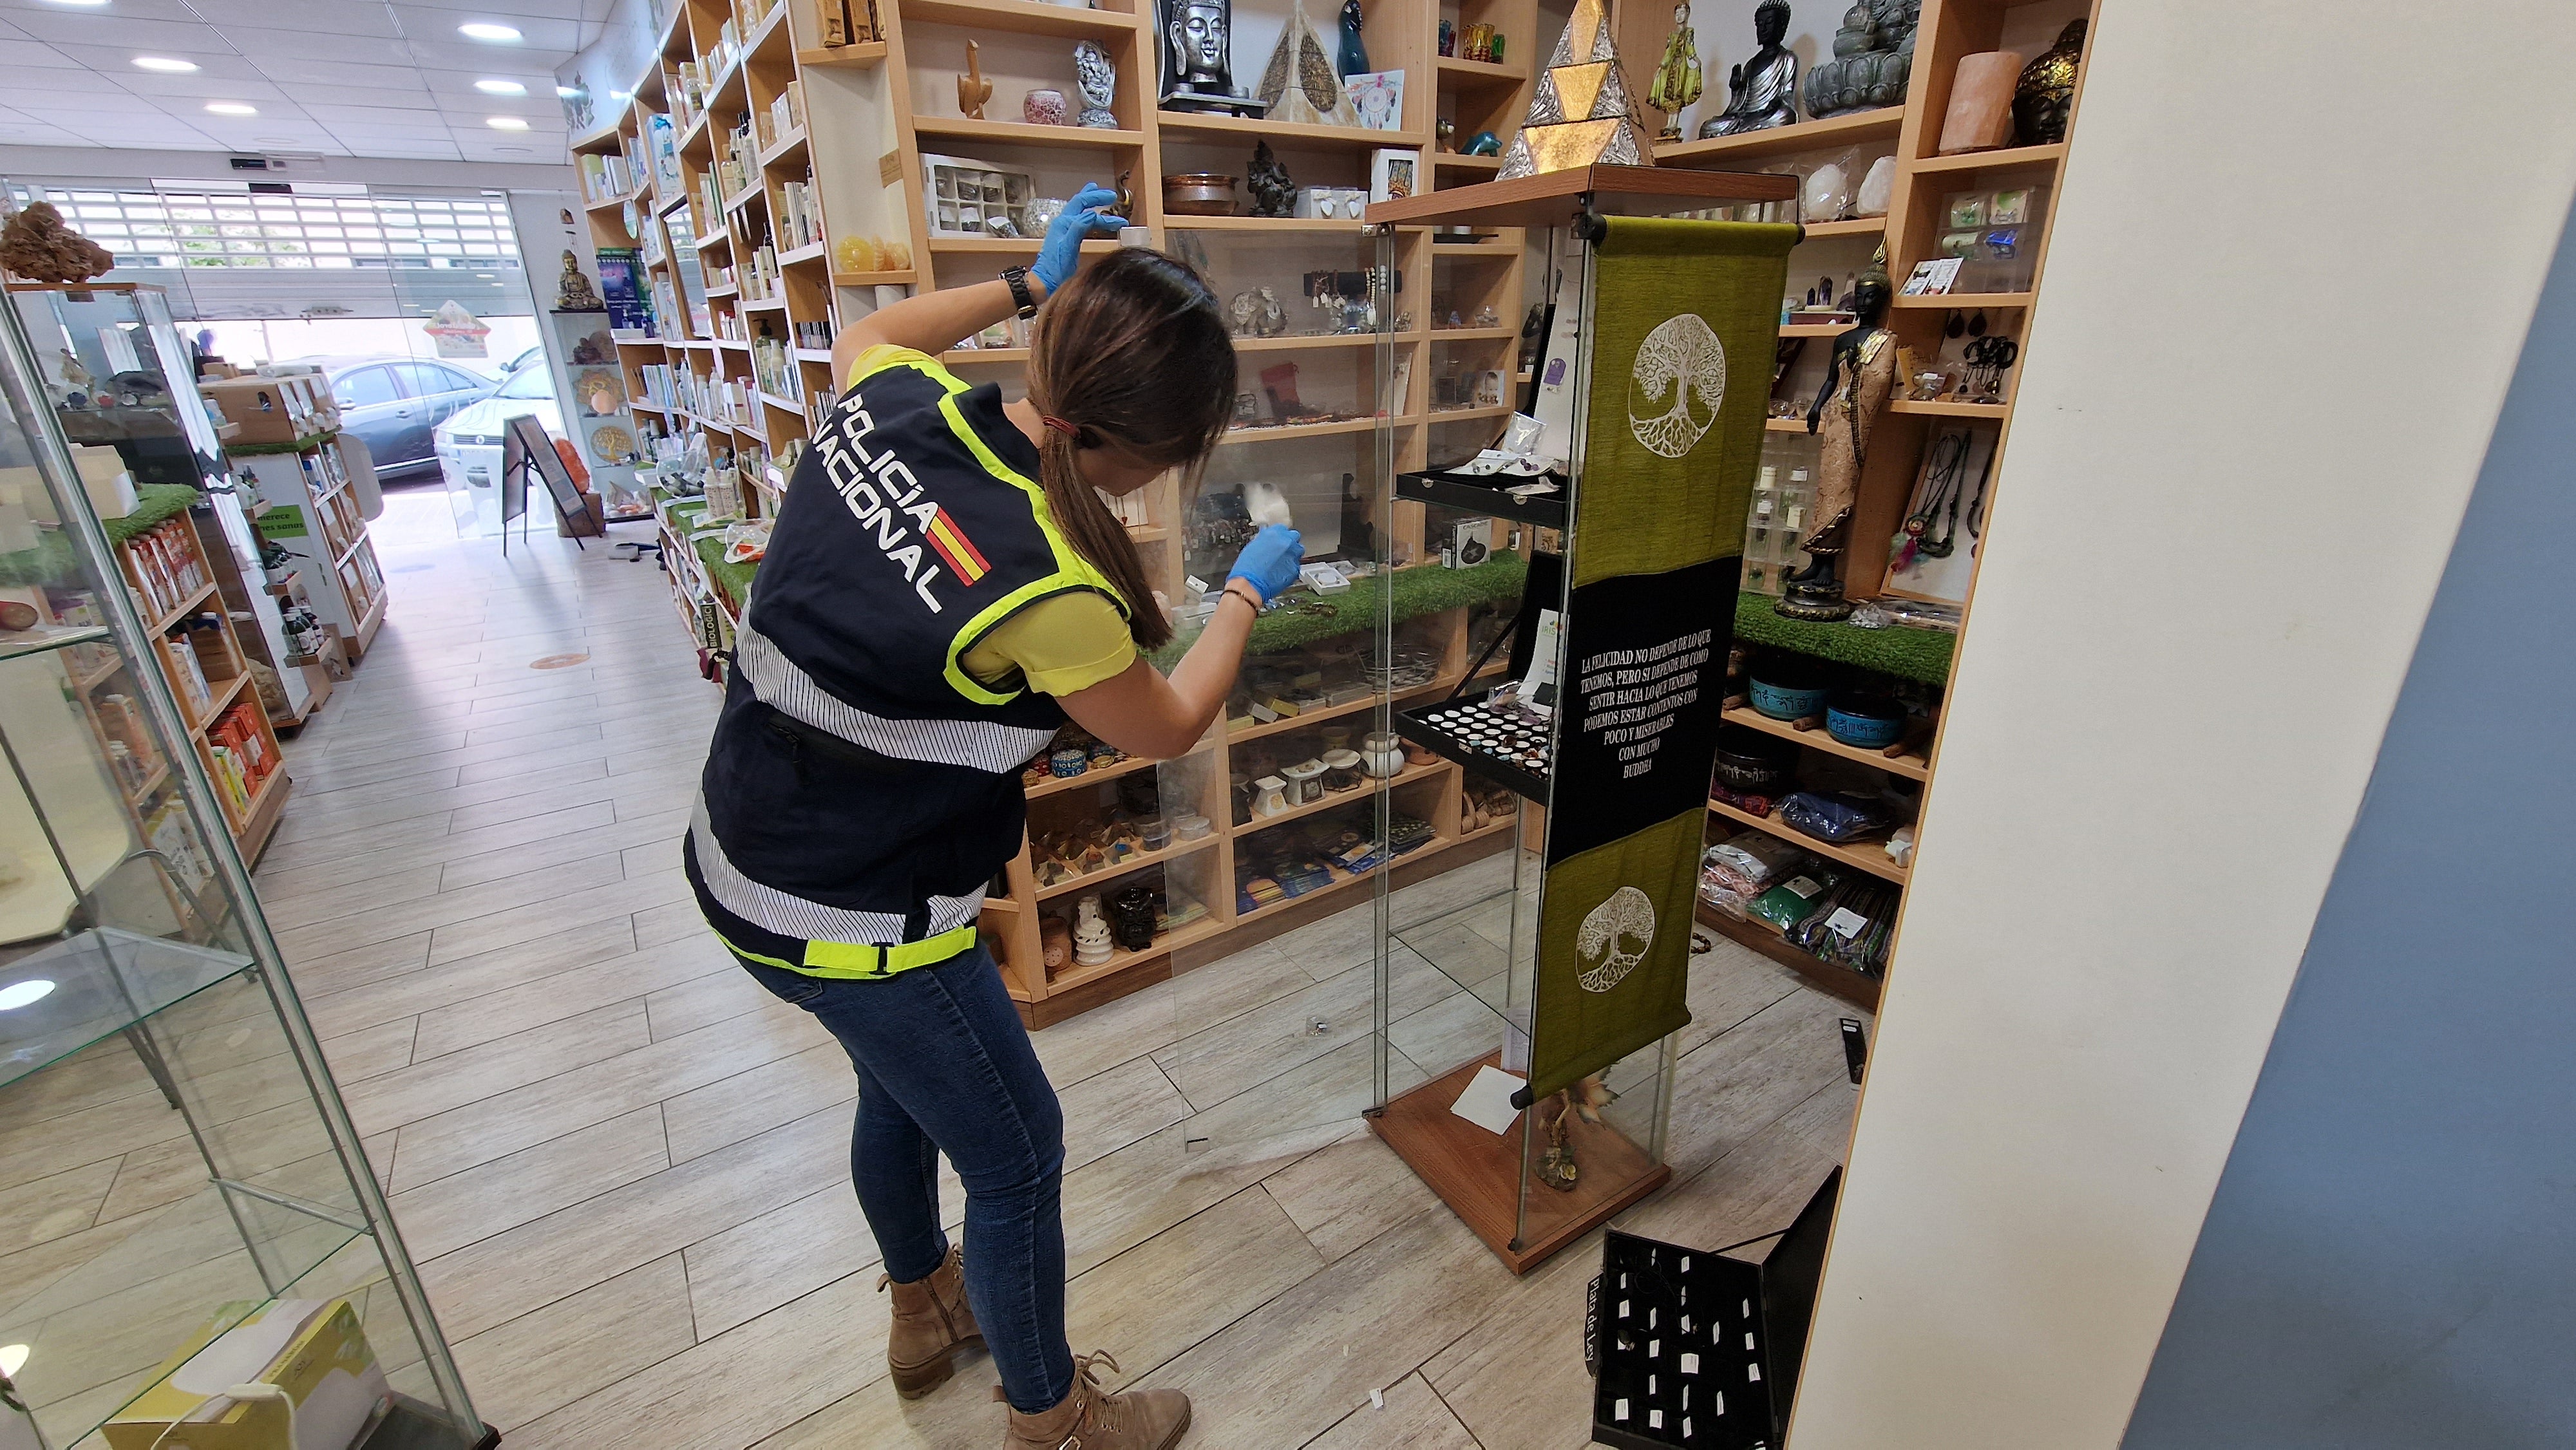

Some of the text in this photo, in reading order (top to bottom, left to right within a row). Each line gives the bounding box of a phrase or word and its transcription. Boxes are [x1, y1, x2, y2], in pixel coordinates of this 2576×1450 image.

[812, 413, 943, 614] NACIONAL
[1581, 648, 1709, 694] TENEMOS, PERO SI DEPENDE DE COMO
[1582, 629, 1711, 673] LA FELICIDAD NO DEPENDE DE LO QUE
[1584, 688, 1698, 733] PODEMOS ESTAR CONTENTOS CON
[1589, 670, 1698, 711] SENTIR HACIA LO QUE TENEMOS
[1604, 713, 1674, 746] POCO Y MISERABLES
[1618, 737, 1660, 762] CON MUCHO
[1623, 757, 1652, 778] BUDDHA
[1585, 1277, 1600, 1361] Plata de Ley
